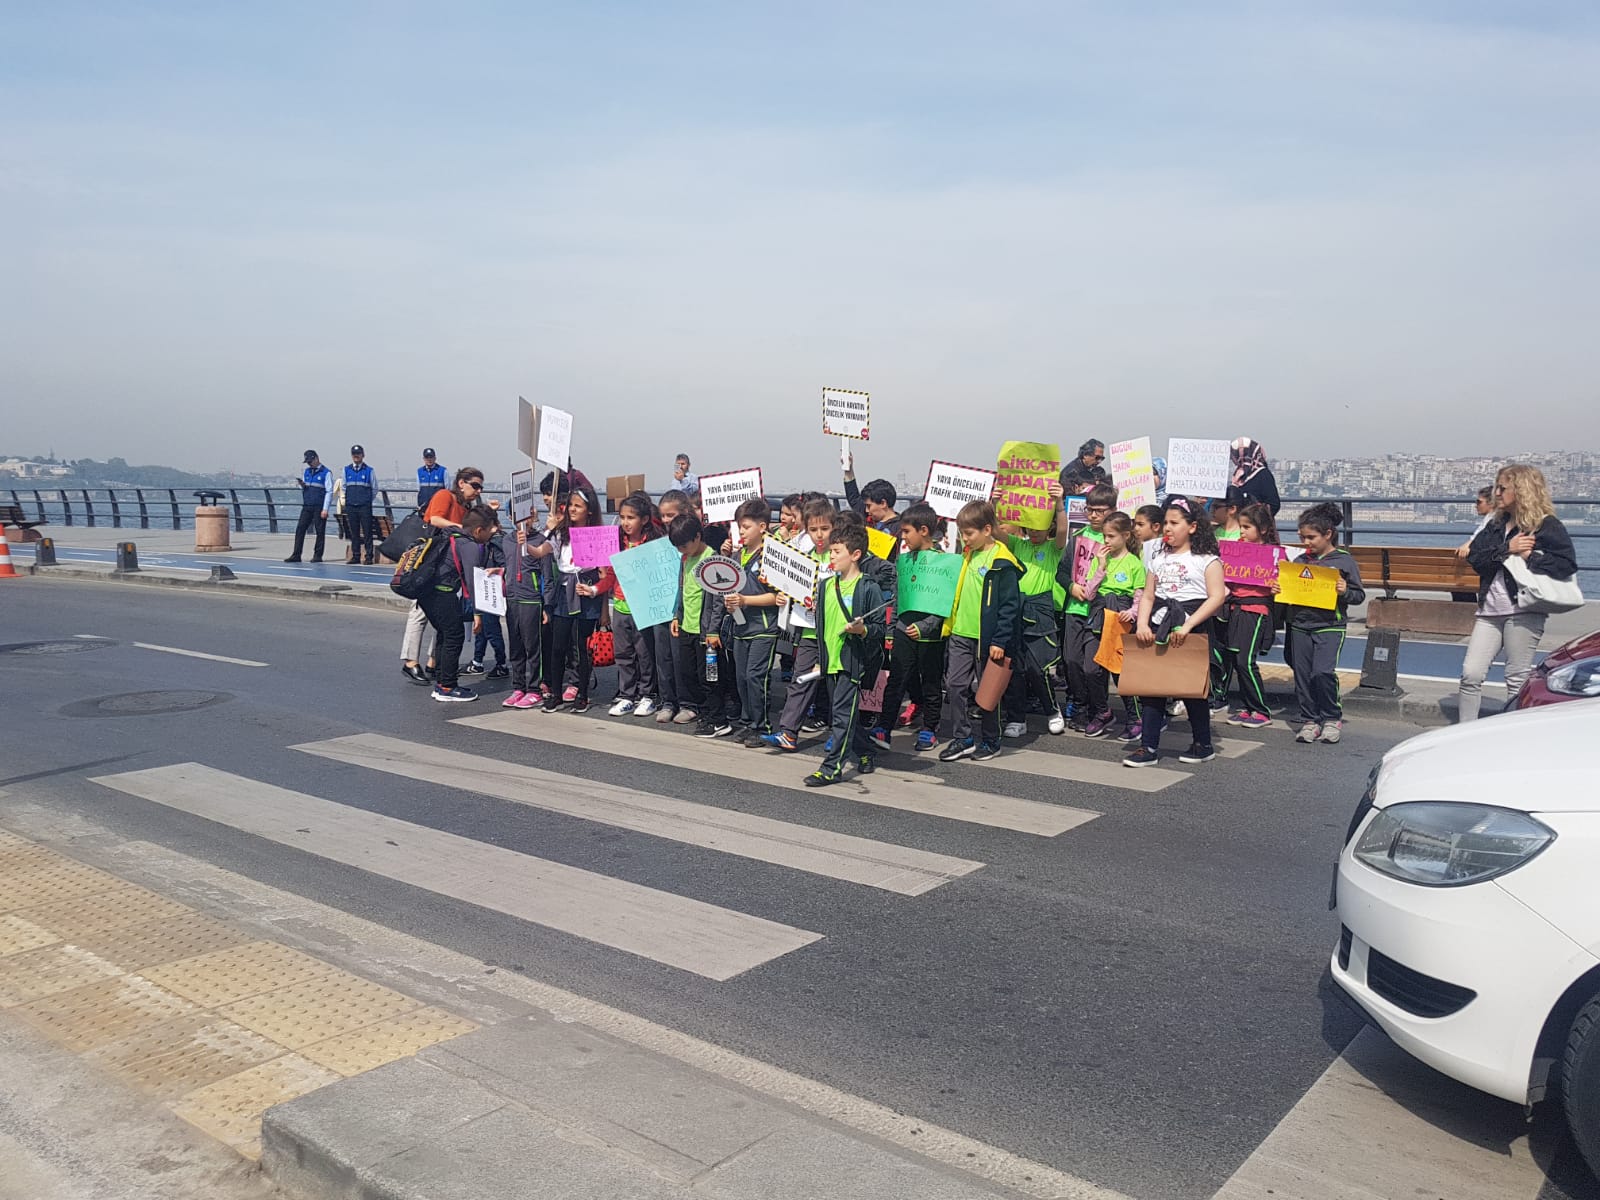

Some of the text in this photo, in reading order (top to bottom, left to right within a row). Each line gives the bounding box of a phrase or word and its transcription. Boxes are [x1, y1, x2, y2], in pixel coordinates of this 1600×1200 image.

[999, 455, 1060, 472] DİKKAT
[707, 479, 754, 495] YAYA ÖNCELİKLİ
[937, 475, 986, 492] YAYA ÖNCELİKLİ
[998, 474, 1057, 490] HAYAT
[705, 495, 726, 506] TRAFİK
[931, 486, 952, 499] TRAFİK
[998, 506, 1021, 521] LİR
[763, 556, 786, 576] ÖNCELİK
[766, 545, 789, 564] ÖNCELİK
[790, 558, 812, 577] HAYATIN
